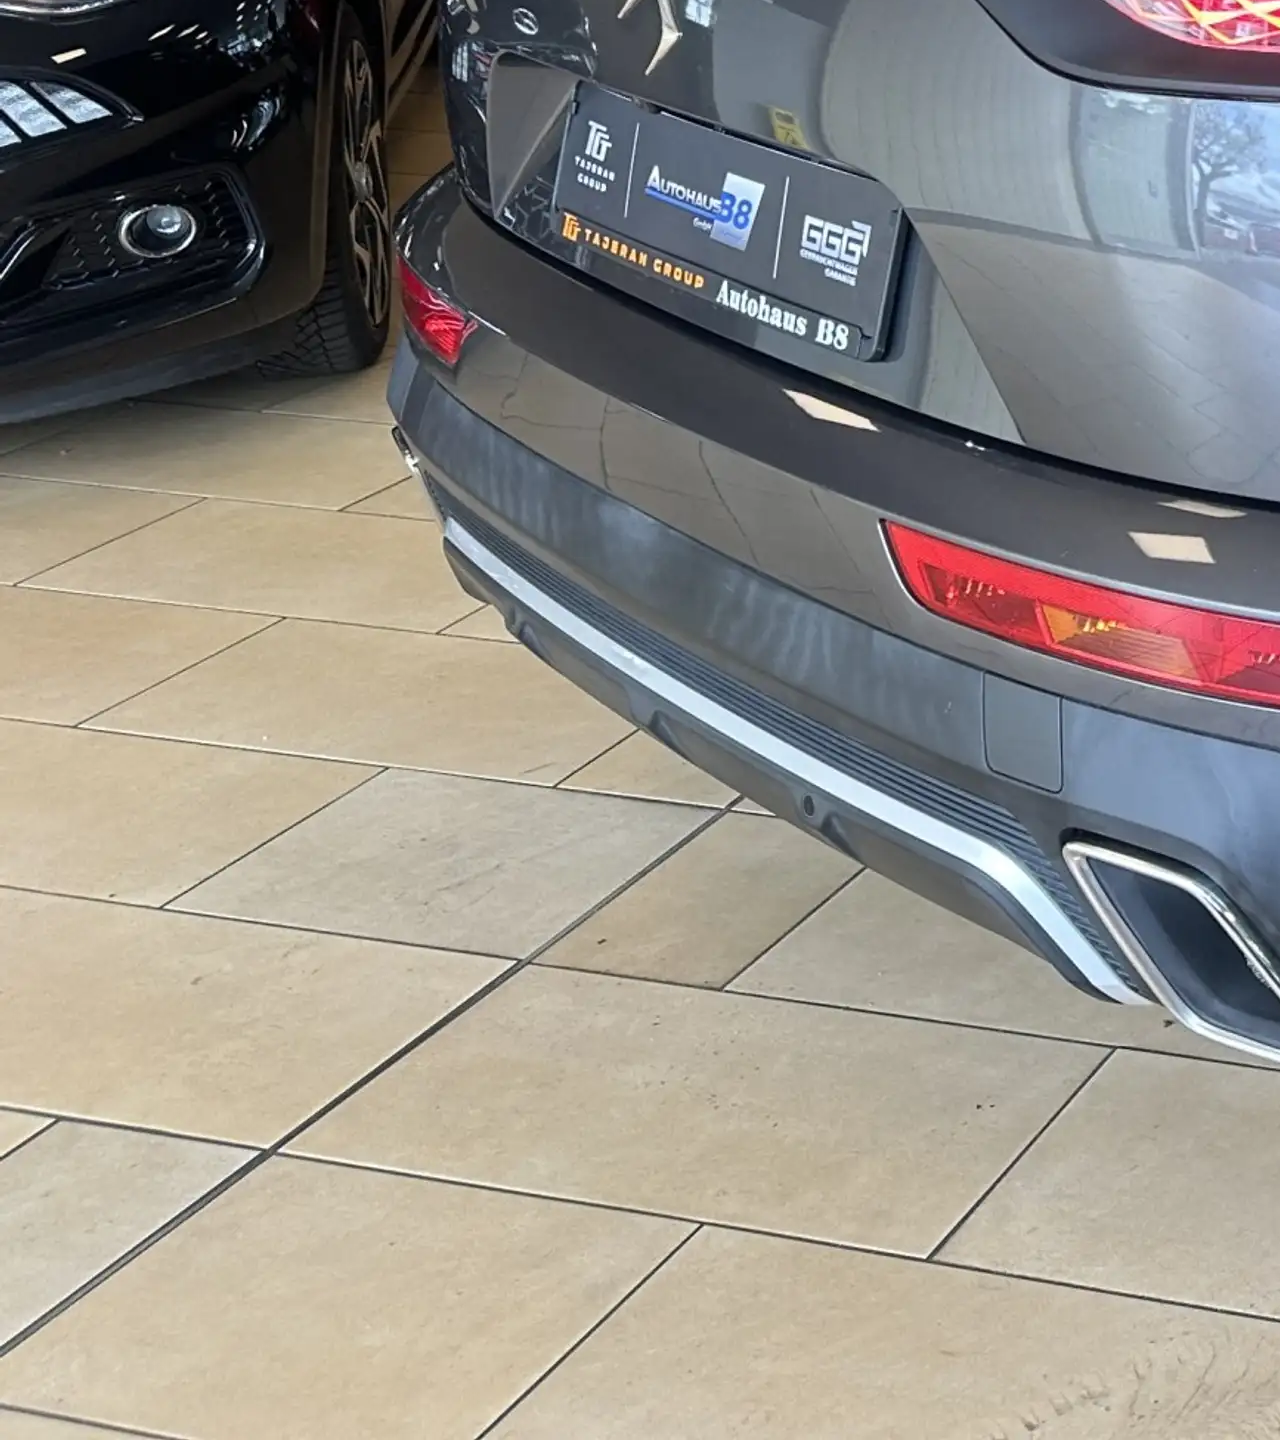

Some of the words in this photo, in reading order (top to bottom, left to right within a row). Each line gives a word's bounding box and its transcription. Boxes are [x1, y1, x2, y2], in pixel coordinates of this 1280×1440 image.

[801, 214, 866, 266] GGG
[652, 257, 706, 289] GROUP
[715, 279, 808, 336] Autohaus
[814, 317, 849, 351] B8
